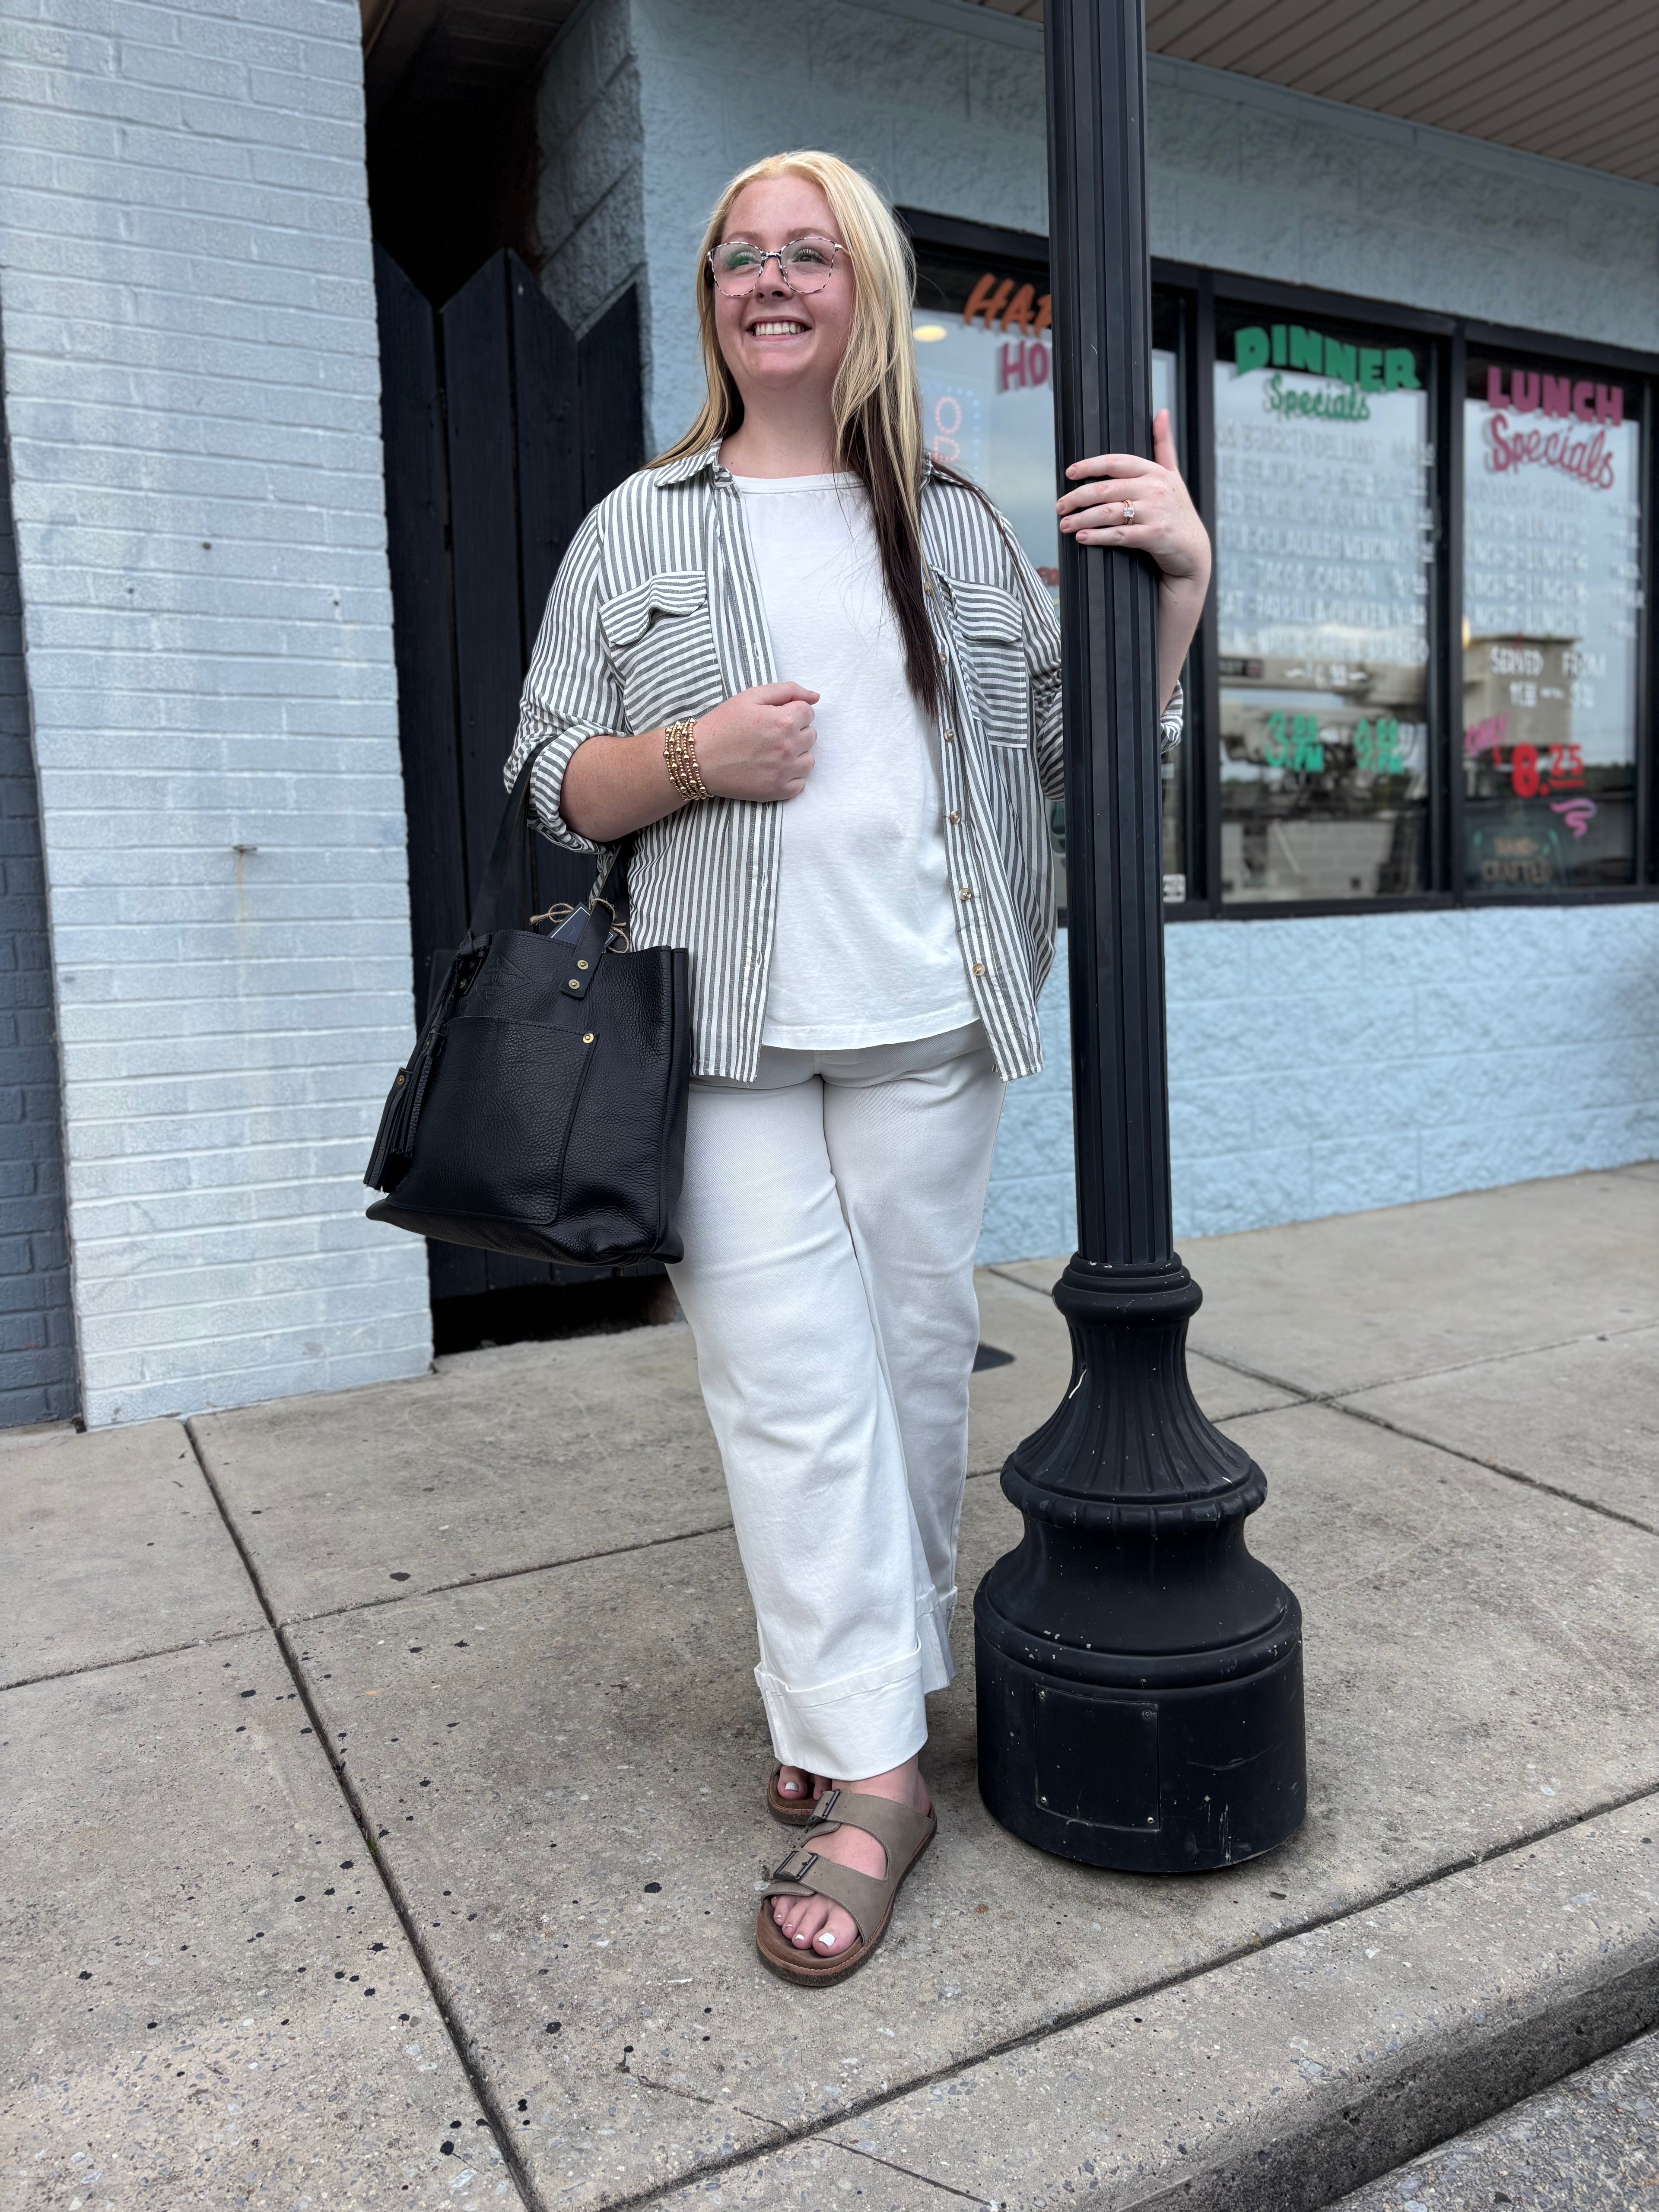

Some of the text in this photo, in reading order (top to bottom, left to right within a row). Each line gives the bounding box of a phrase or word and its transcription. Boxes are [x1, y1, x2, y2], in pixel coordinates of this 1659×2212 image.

[1234, 325, 1422, 392] DINNER
[1269, 373, 1371, 420] Specials
[1487, 366, 1623, 427] LUNCH
[1491, 413, 1614, 490] Specials
